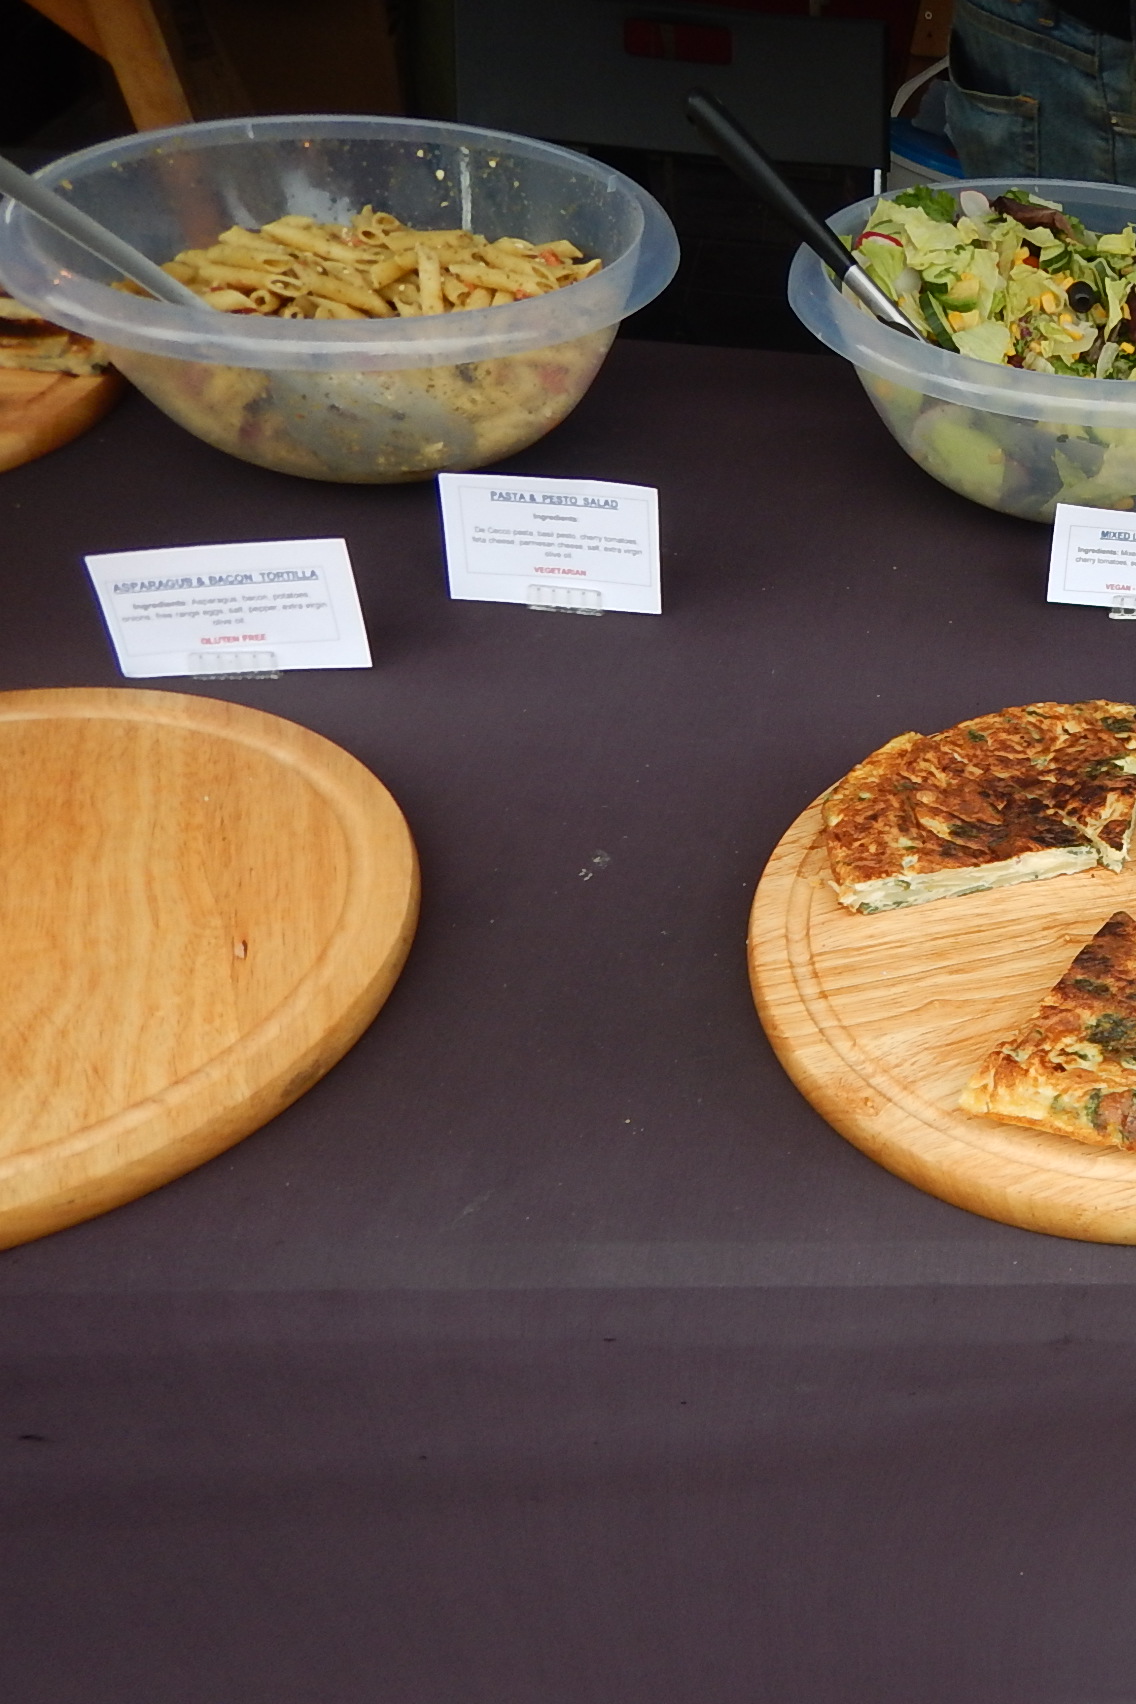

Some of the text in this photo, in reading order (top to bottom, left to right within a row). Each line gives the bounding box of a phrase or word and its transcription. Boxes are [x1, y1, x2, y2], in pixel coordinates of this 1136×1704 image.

[490, 490, 619, 510] PASTA & PESTO SALAD
[1100, 530, 1131, 542] MIXED
[533, 566, 587, 577] VEGETARIAN
[113, 569, 319, 593] ASPARAGUS & BACON TORTILLA
[1105, 583, 1132, 591] VEGAN
[200, 633, 267, 645] GLUTEN FREE
